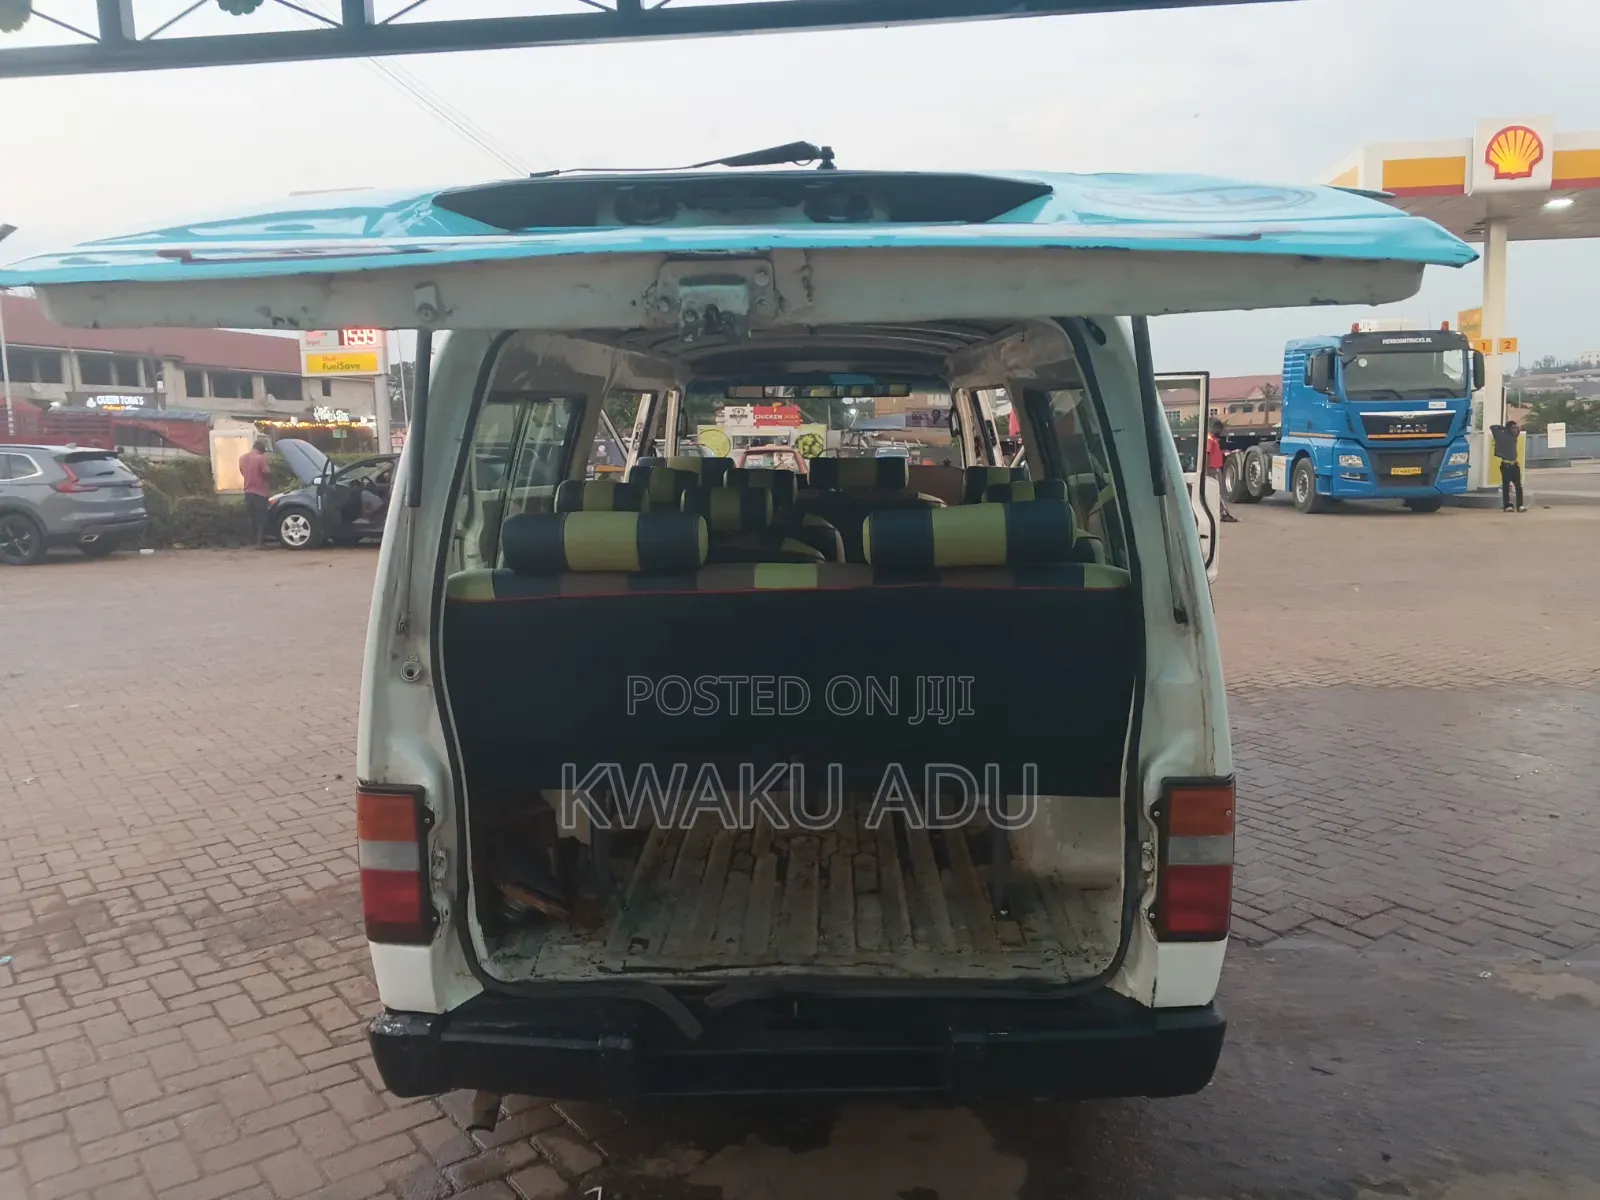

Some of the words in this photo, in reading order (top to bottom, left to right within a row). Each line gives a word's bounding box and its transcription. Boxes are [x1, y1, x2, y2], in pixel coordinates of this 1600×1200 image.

[1481, 342, 1486, 351] 1
[1503, 340, 1511, 350] 2
[322, 361, 361, 370] FuelSave
[1388, 424, 1428, 433] MAN
